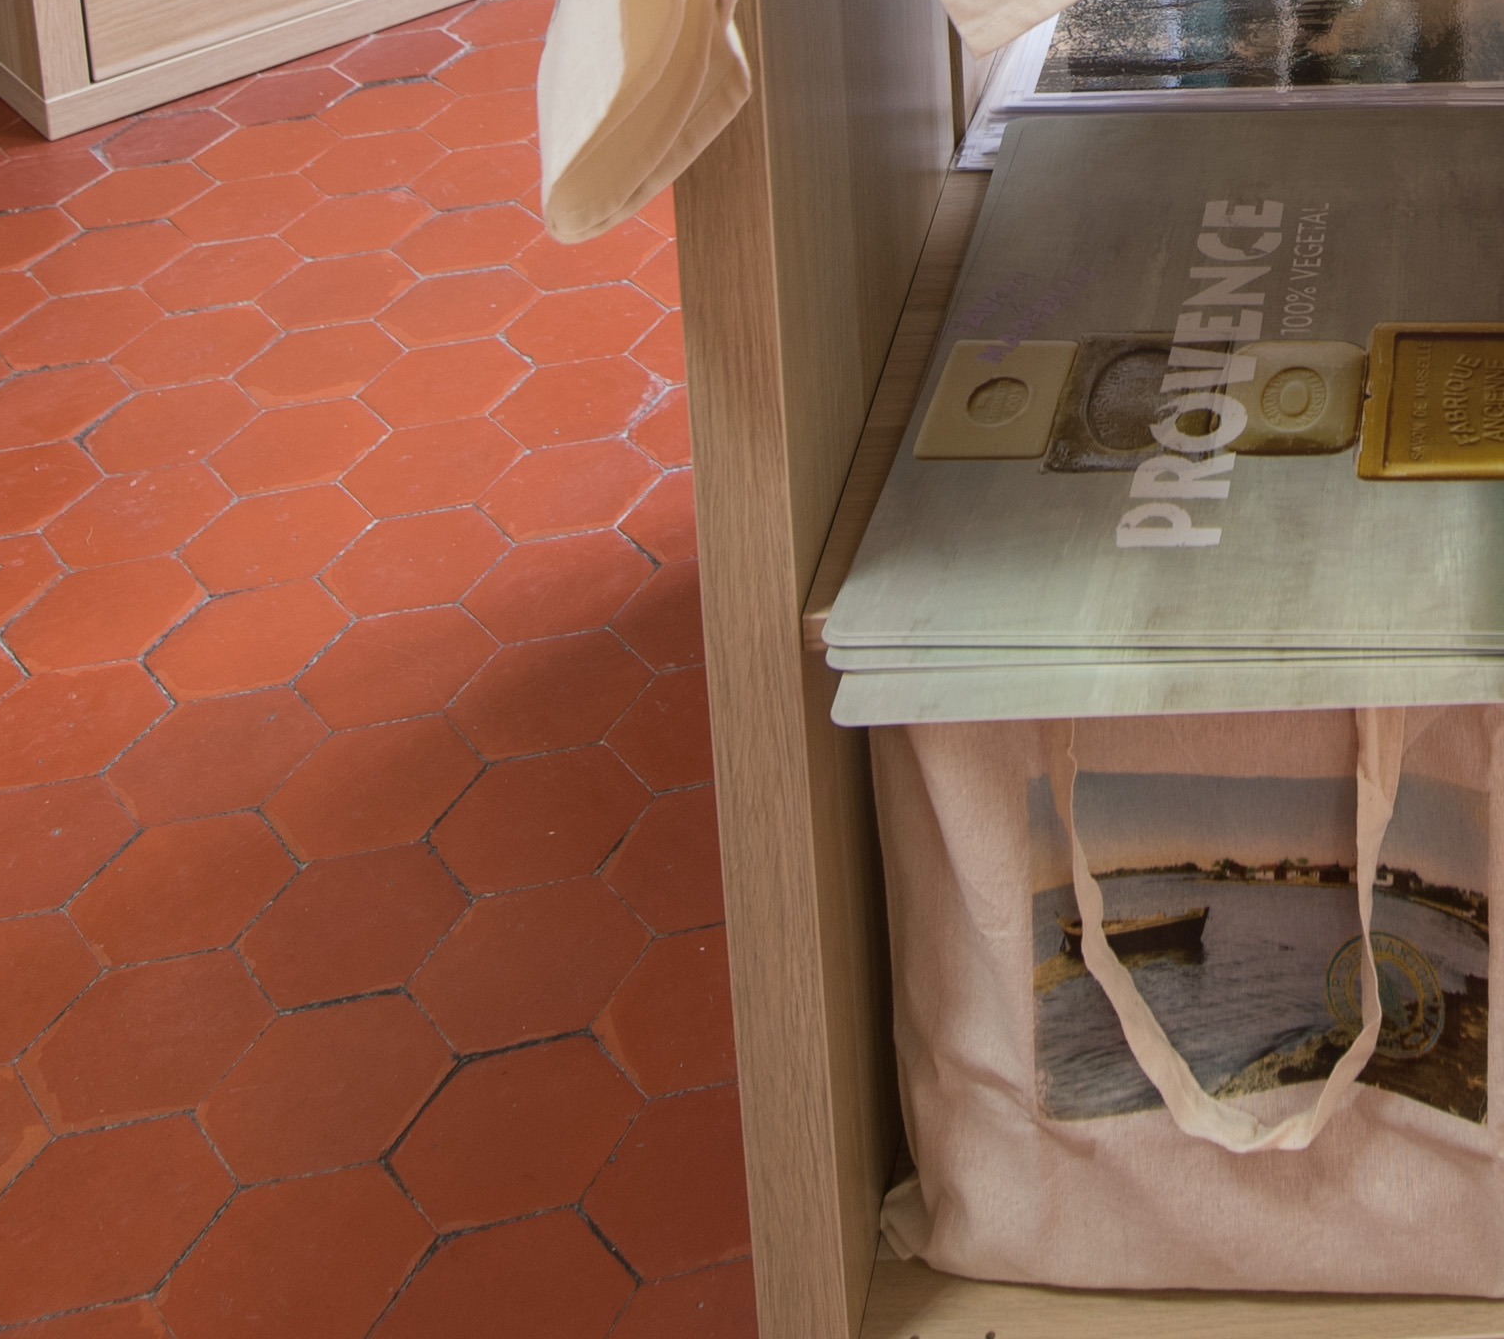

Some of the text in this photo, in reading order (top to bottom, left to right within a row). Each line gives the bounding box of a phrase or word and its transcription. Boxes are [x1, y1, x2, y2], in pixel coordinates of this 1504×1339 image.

[1280, 201, 1332, 337] 100% VEGETAL
[1116, 198, 1285, 550] PROVENCE
[1414, 401, 1428, 421] DE
[1441, 352, 1484, 448] FABRIQUE
[1408, 423, 1426, 463] SAVON
